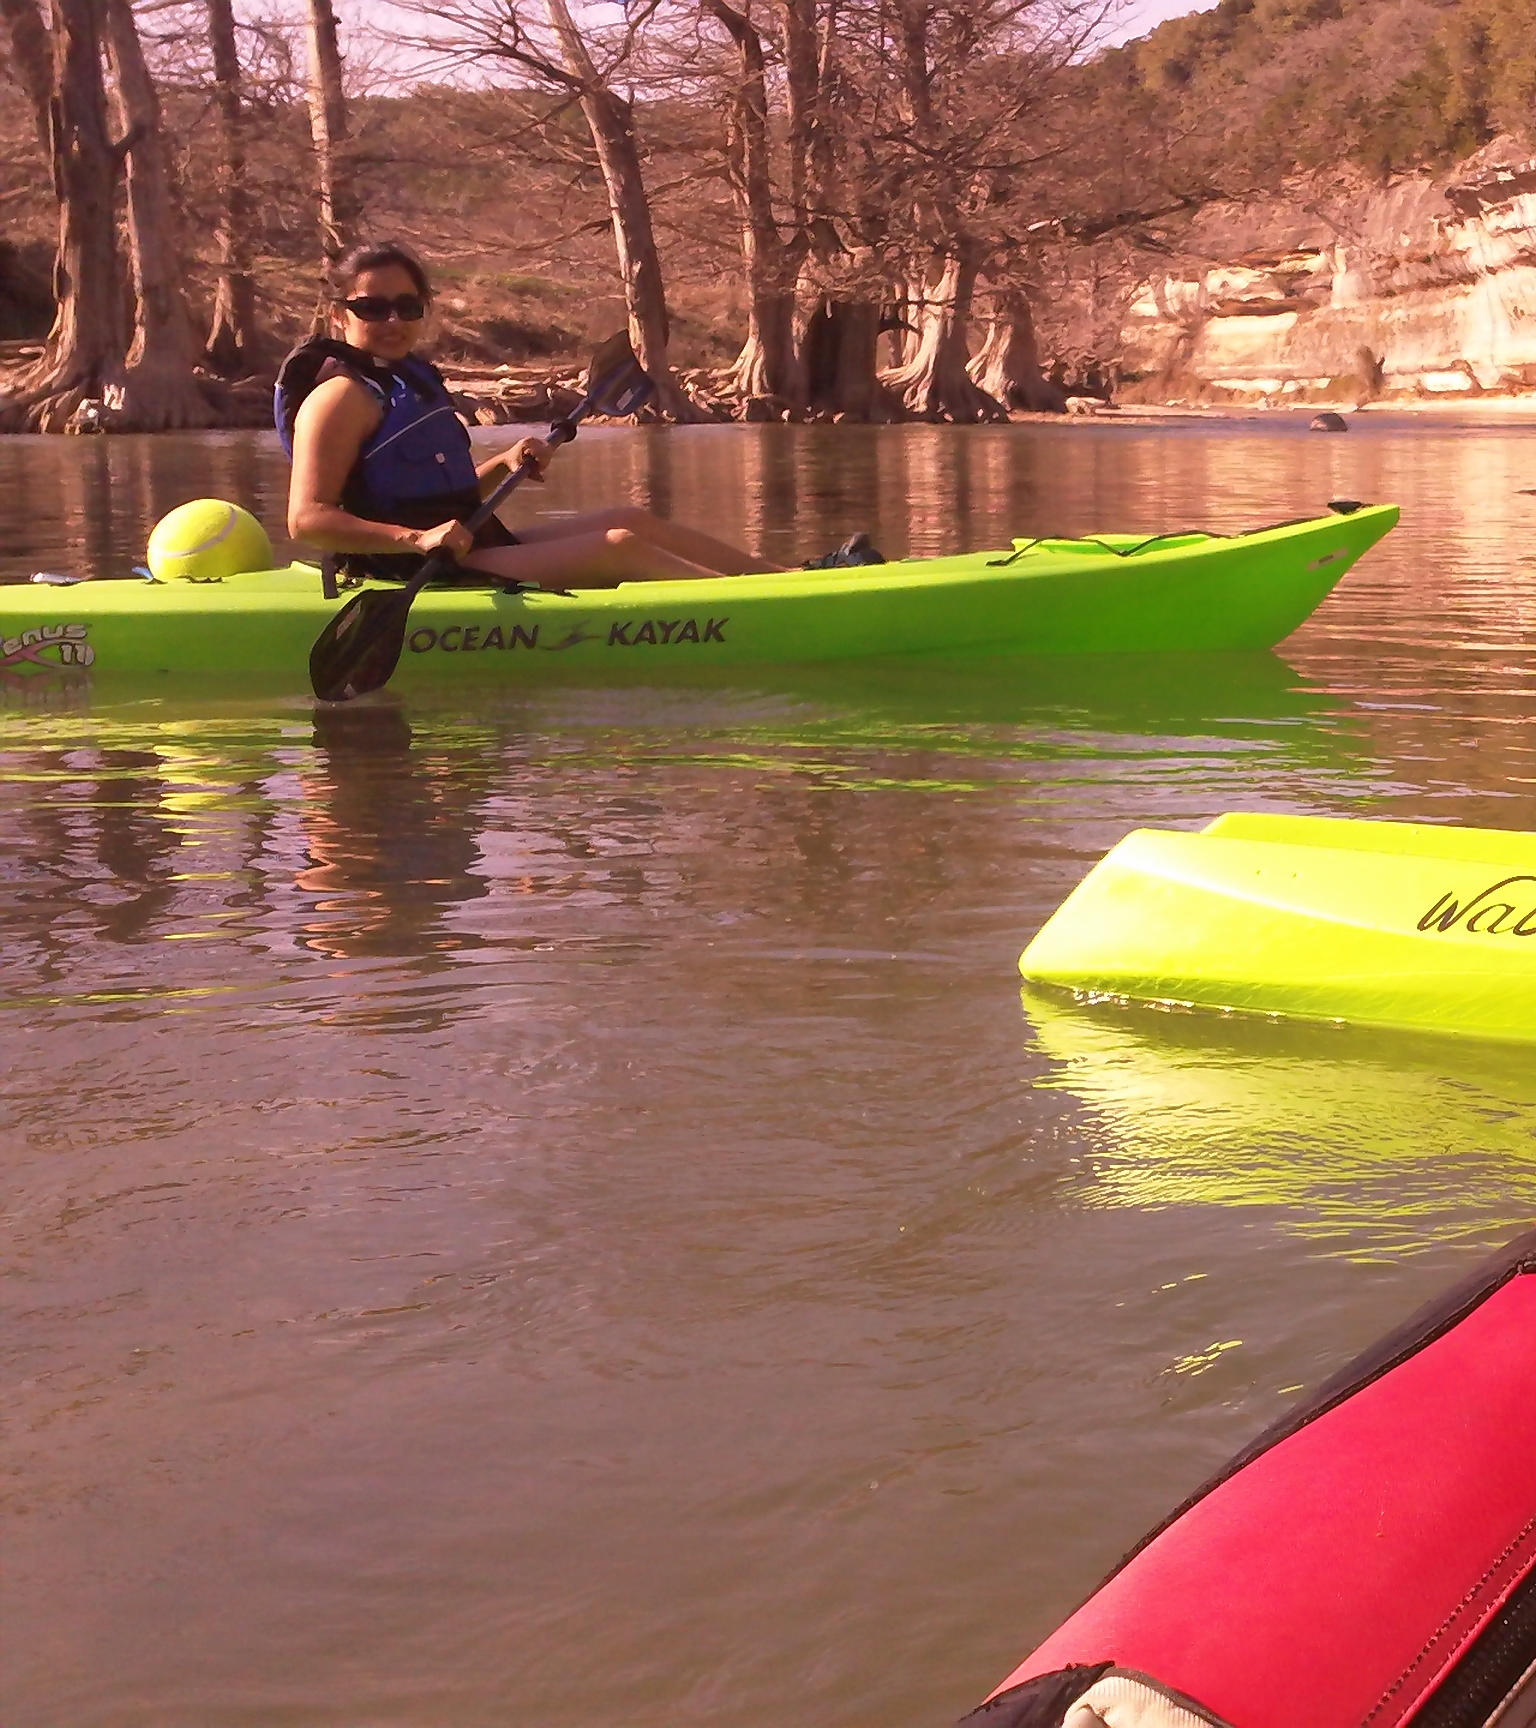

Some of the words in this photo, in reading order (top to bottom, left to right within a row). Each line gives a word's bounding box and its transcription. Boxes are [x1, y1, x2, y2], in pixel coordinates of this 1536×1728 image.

[0, 623, 88, 656] enus
[408, 625, 540, 653] OCEAN
[607, 617, 730, 646] KAYAK
